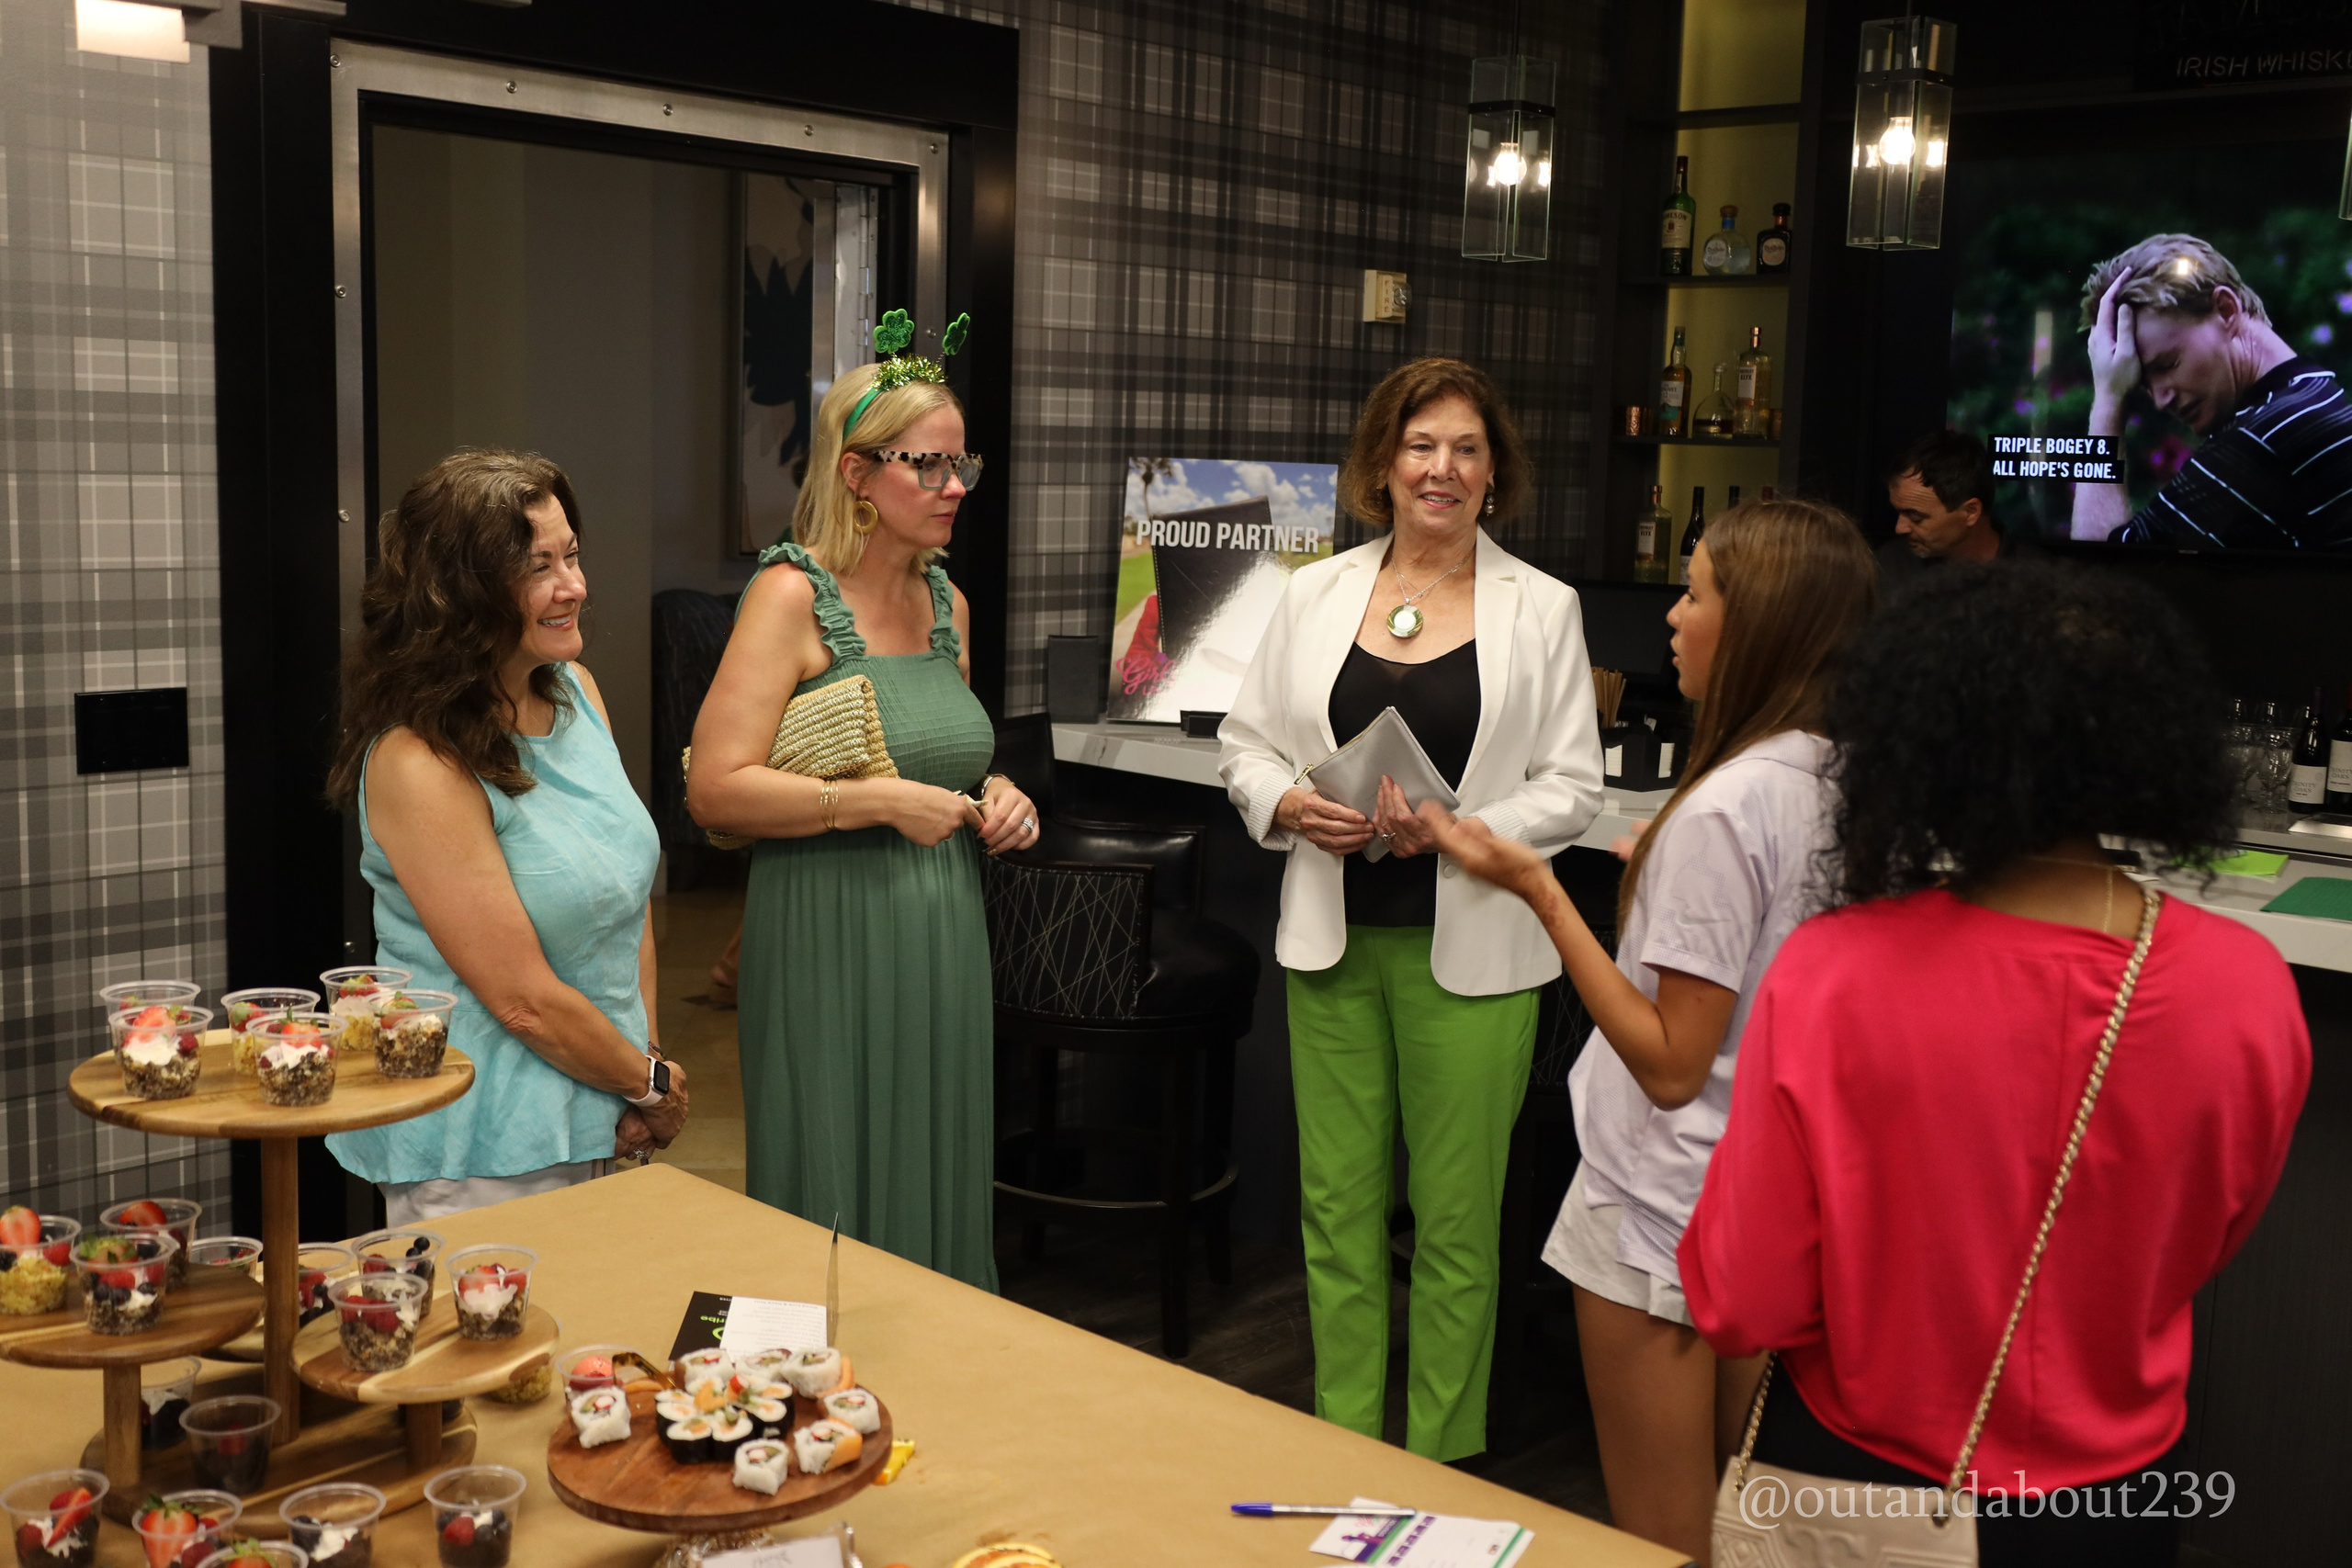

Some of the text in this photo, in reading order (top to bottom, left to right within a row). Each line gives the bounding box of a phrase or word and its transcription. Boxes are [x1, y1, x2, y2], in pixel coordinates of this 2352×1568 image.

[2176, 56, 2249, 78] IRISH
[1994, 436, 2110, 455] TRIPLE BOGEY 8.
[1993, 460, 2117, 479] ALL HOPE'S GONE.
[1136, 519, 1319, 554] PROUD PARTNER
[700, 1315, 725, 1324] ribe
